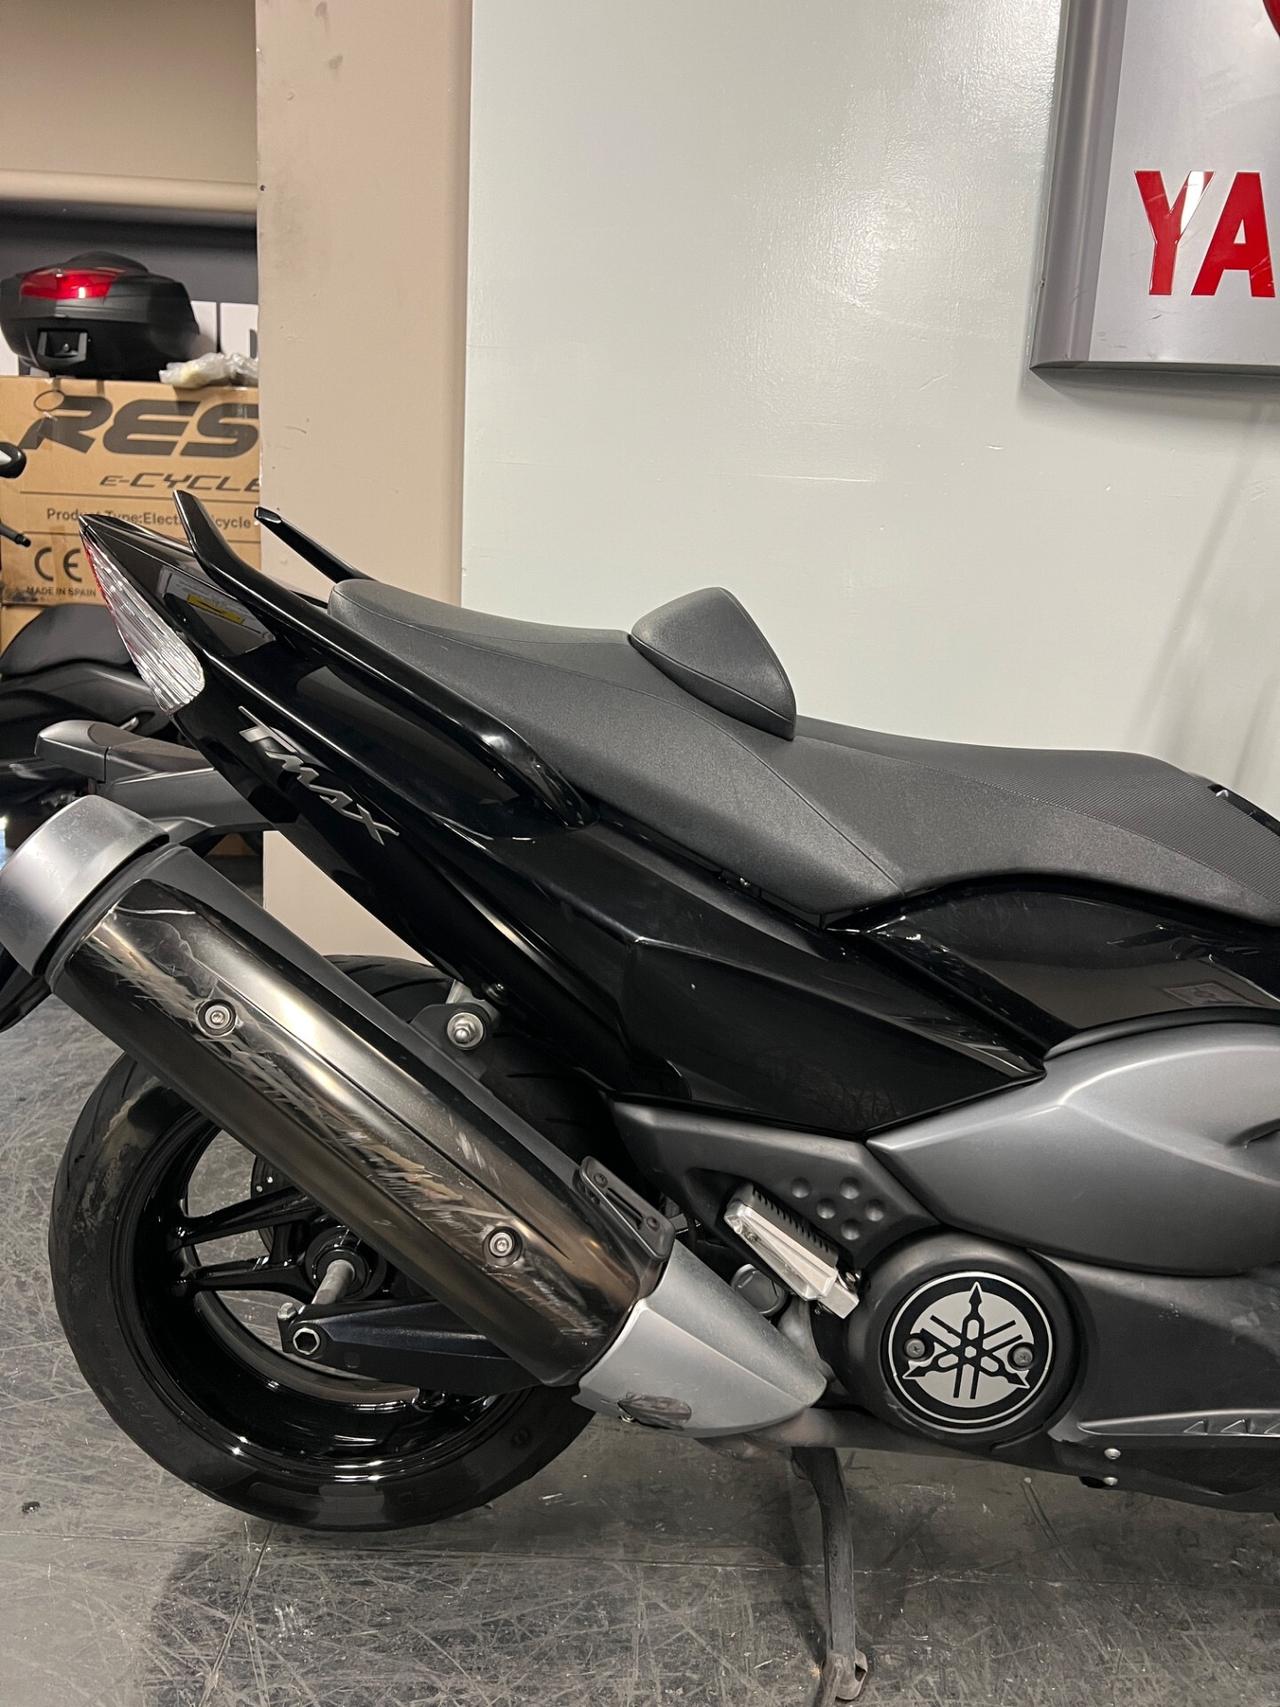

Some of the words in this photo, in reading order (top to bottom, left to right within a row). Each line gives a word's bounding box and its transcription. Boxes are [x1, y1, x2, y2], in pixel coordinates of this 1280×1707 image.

[34, 546, 83, 583] CE
[26, 586, 55, 596] MADE
[56, 587, 66, 596] IN
[68, 587, 97, 598] SPAIN
